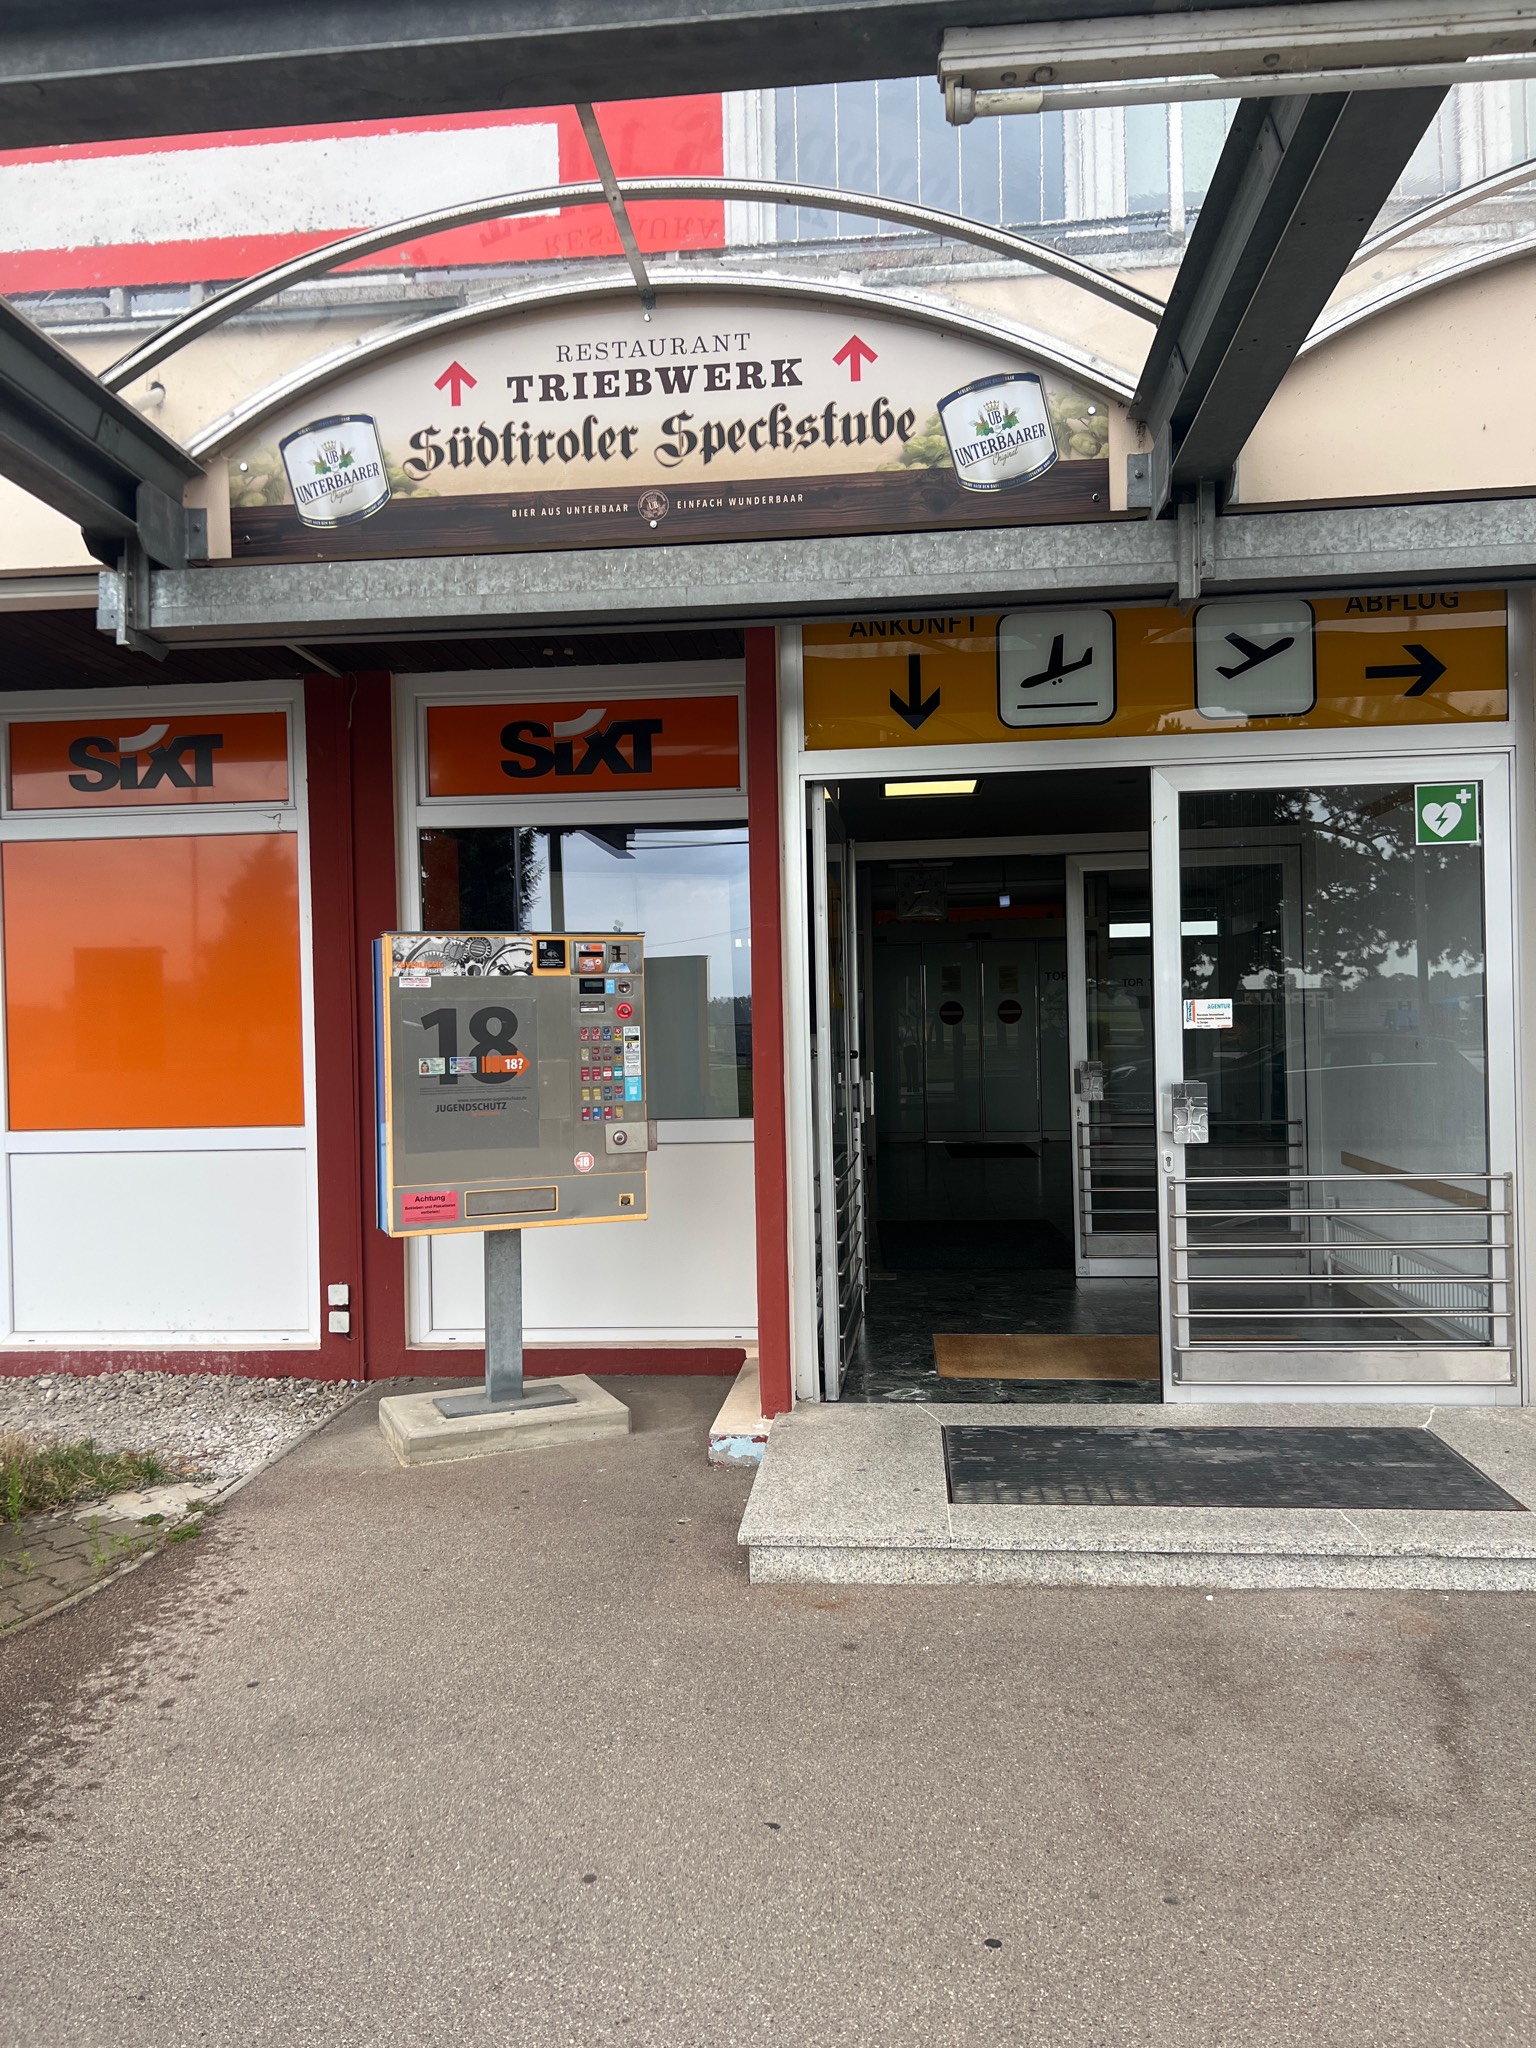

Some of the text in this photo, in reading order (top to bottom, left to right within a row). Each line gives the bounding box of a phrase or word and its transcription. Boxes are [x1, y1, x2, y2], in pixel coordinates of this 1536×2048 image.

[556, 333, 751, 363] RESTAURANT
[506, 358, 803, 404] TRIEBWERK
[987, 410, 1003, 426] UB
[402, 396, 917, 481] Südtiroler Speckstube
[954, 422, 1047, 467] UNTERBAARER
[325, 450, 340, 465] UB
[992, 445, 1020, 467] Original
[296, 462, 380, 504] UNTERBAARER
[330, 484, 355, 504] Original
[677, 498, 724, 509] EINFACH
[729, 493, 804, 507] WUNDERBAAR
[511, 503, 630, 518] BIER AUS UNTERBAAR
[1345, 591, 1459, 614] ABFLUG
[1121, 978, 1144, 987] TOR
[420, 1006, 519, 1086] 18
[504, 1058, 524, 1070] 18?
[435, 1102, 507, 1113] JUGENDSCHUTZ
[414, 1195, 446, 1203] Achtung
